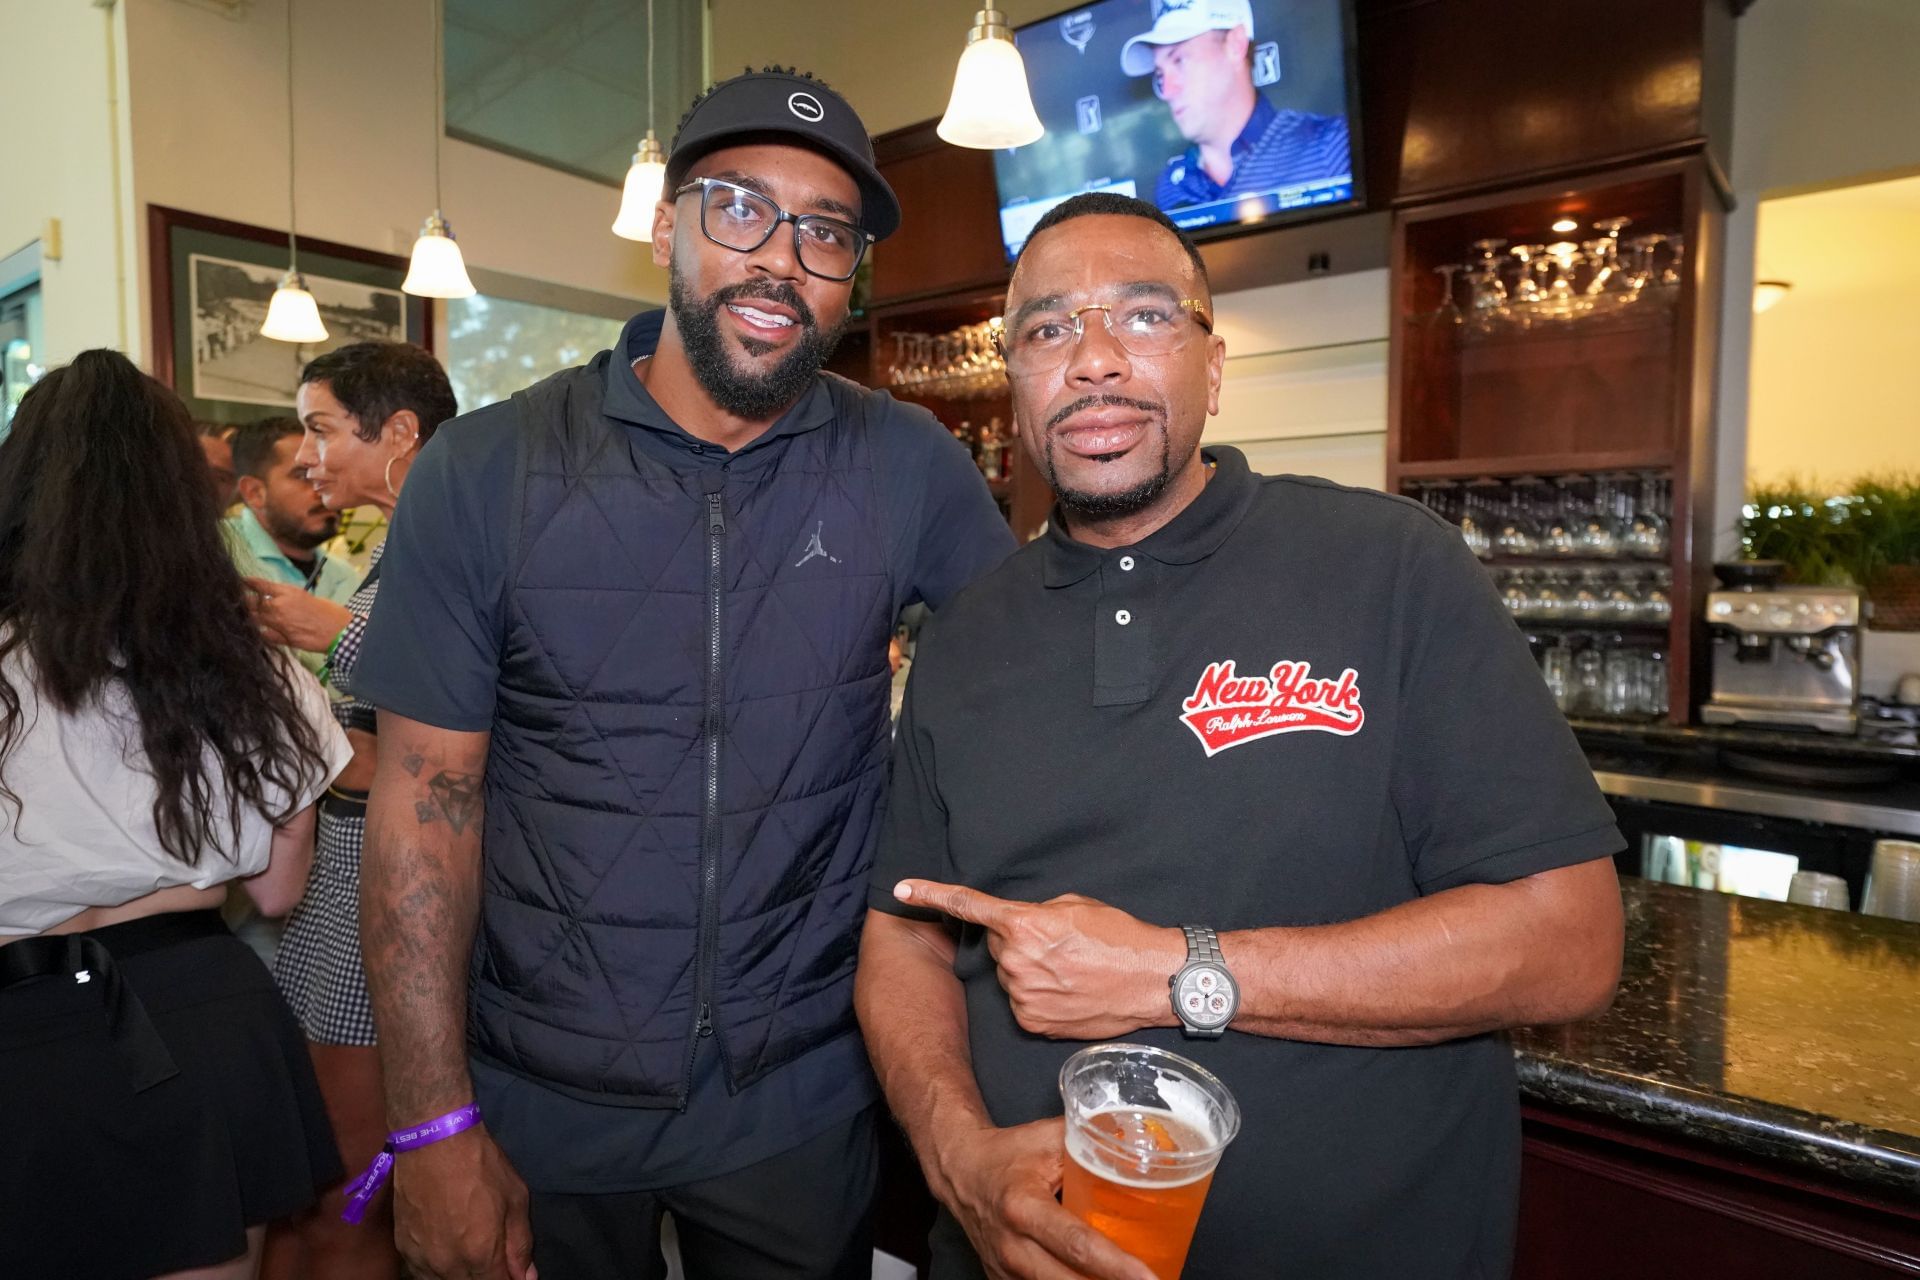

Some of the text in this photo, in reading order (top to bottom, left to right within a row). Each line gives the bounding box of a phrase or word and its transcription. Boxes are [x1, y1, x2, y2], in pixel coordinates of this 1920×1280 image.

[1183, 660, 1360, 711] New York
[1206, 713, 1252, 734] Ralph
[395, 1131, 418, 1144] BEST
[420, 1124, 441, 1137] THE
[365, 1152, 388, 1190] OLFER
